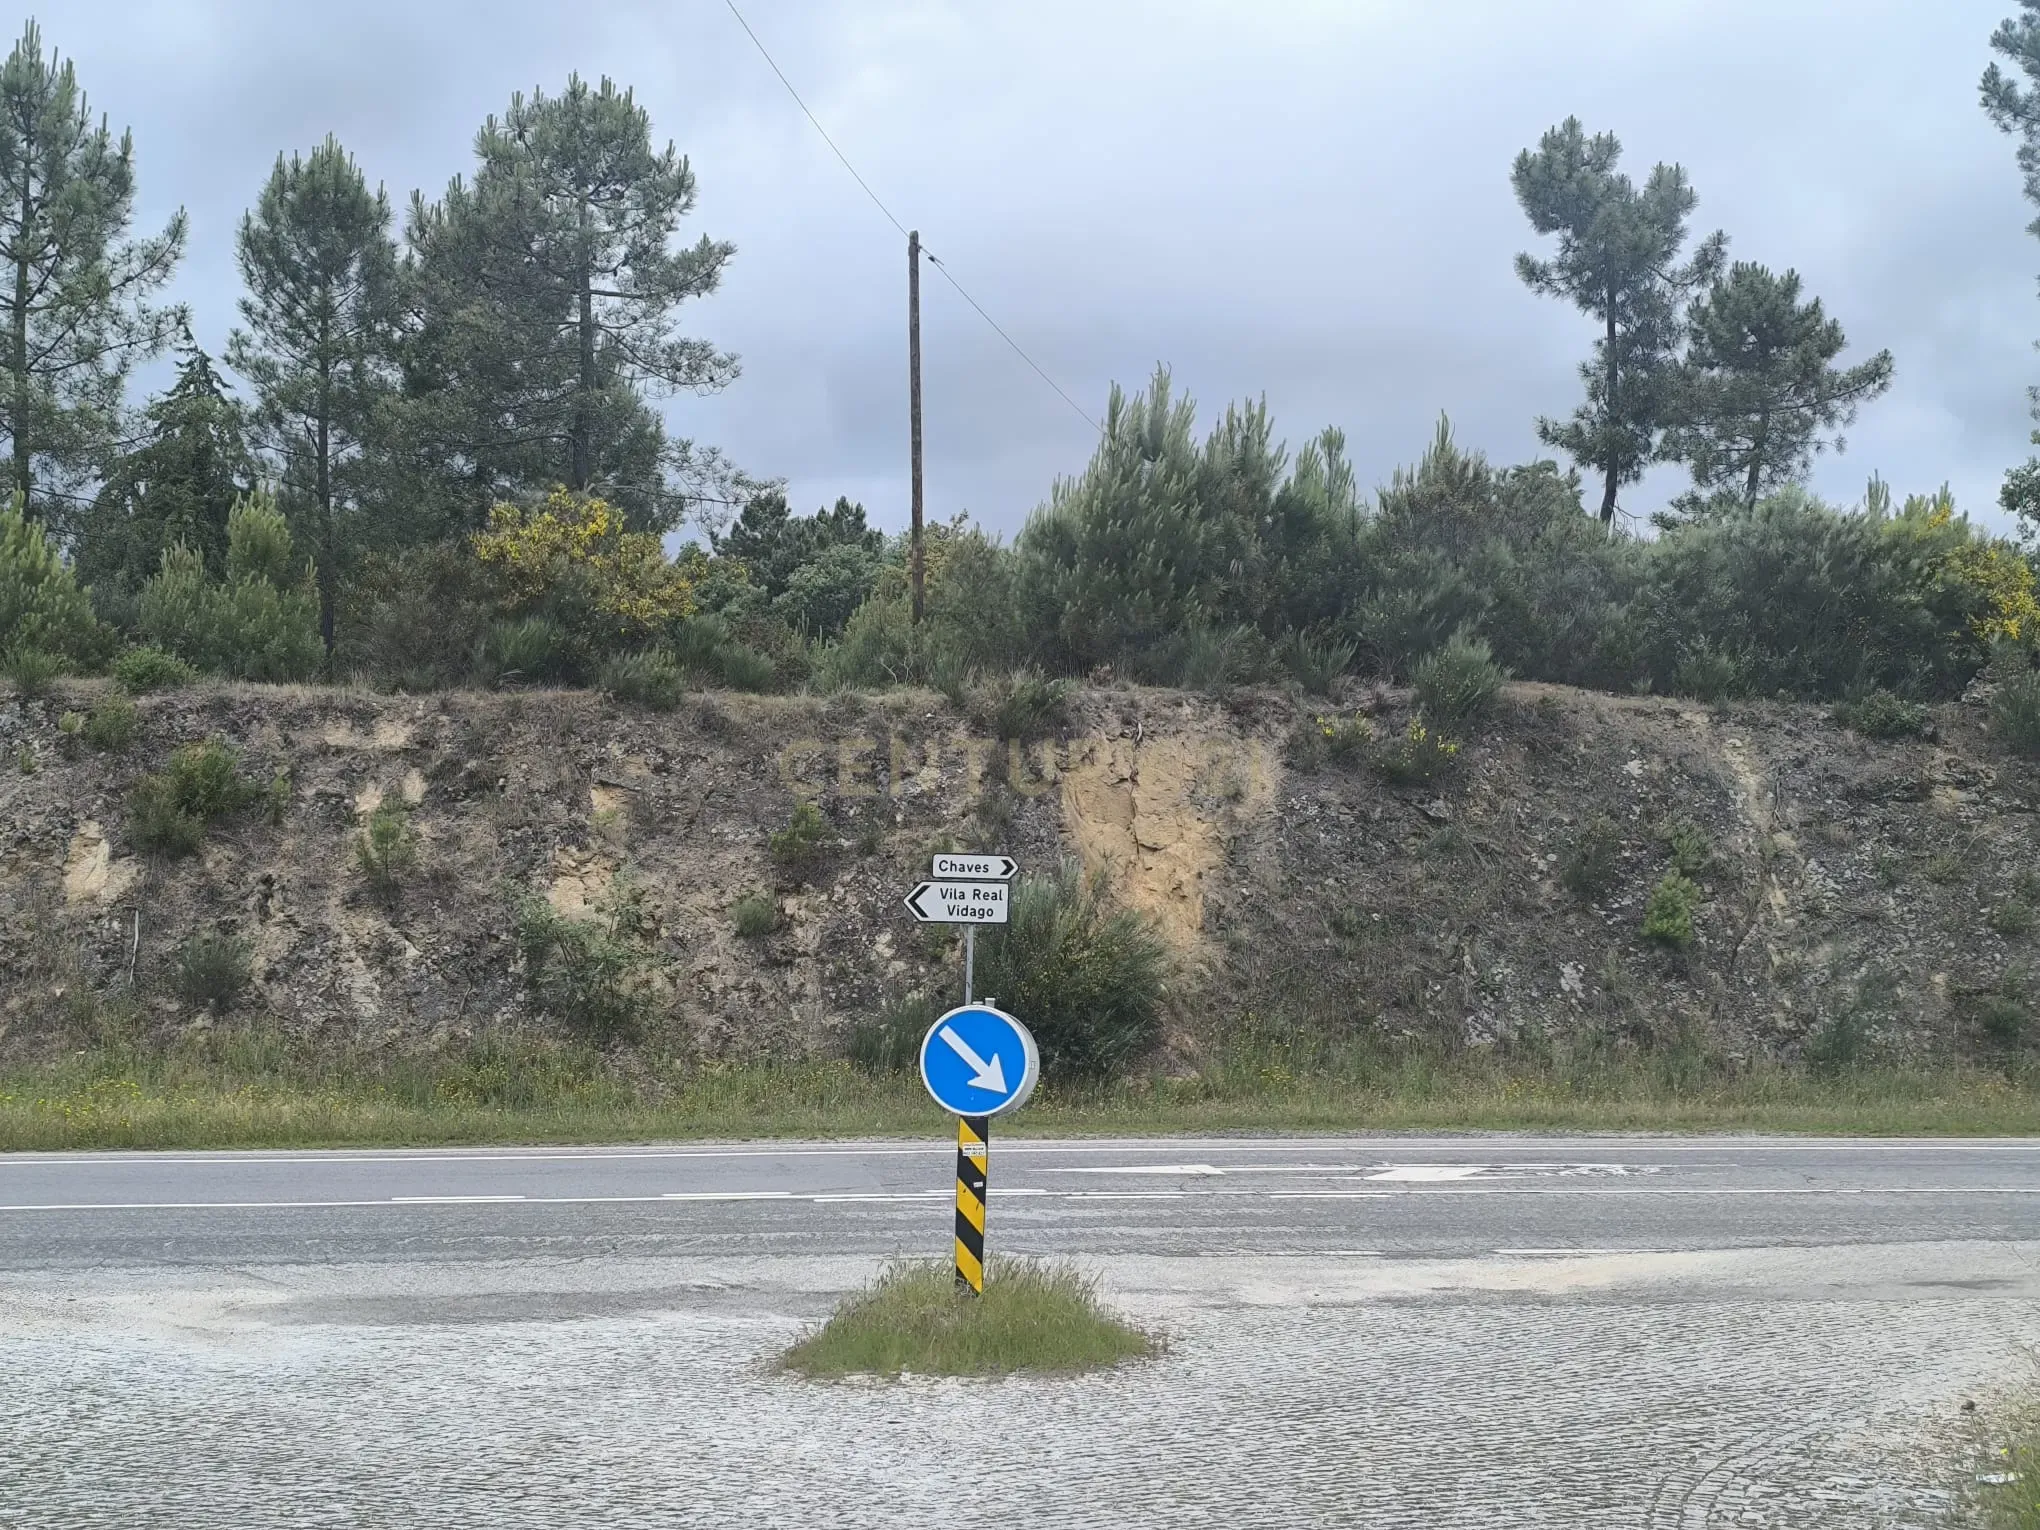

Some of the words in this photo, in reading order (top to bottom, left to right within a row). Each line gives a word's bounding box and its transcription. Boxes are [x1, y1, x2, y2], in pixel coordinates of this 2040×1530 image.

[938, 860, 990, 873] Chaves
[940, 888, 966, 900] Vila
[973, 889, 1003, 901] Real
[947, 904, 994, 919] Vidago
